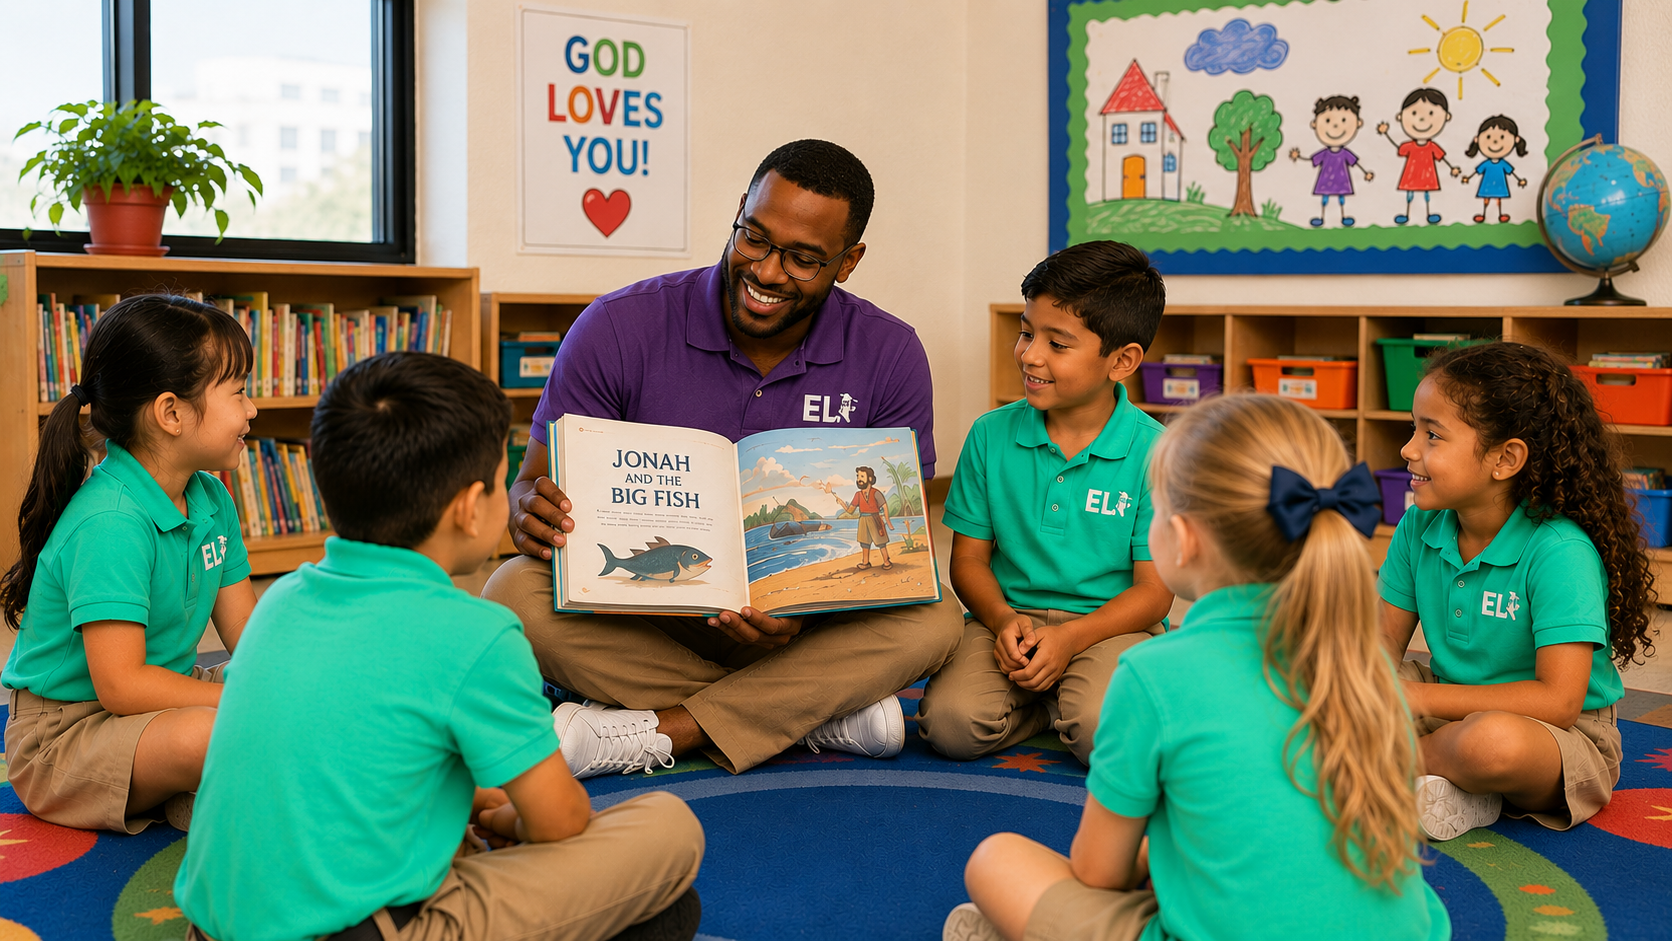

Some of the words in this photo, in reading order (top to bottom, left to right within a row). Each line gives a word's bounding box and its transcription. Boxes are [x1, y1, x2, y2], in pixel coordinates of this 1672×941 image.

[565, 35, 646, 78] GOD
[547, 83, 664, 129] LOVES
[563, 135, 649, 176] YOU!
[612, 449, 691, 472] JONAH
[625, 473, 653, 484] AND
[656, 475, 682, 486] THE
[611, 487, 648, 505] BIG
[653, 490, 700, 509] FISH
